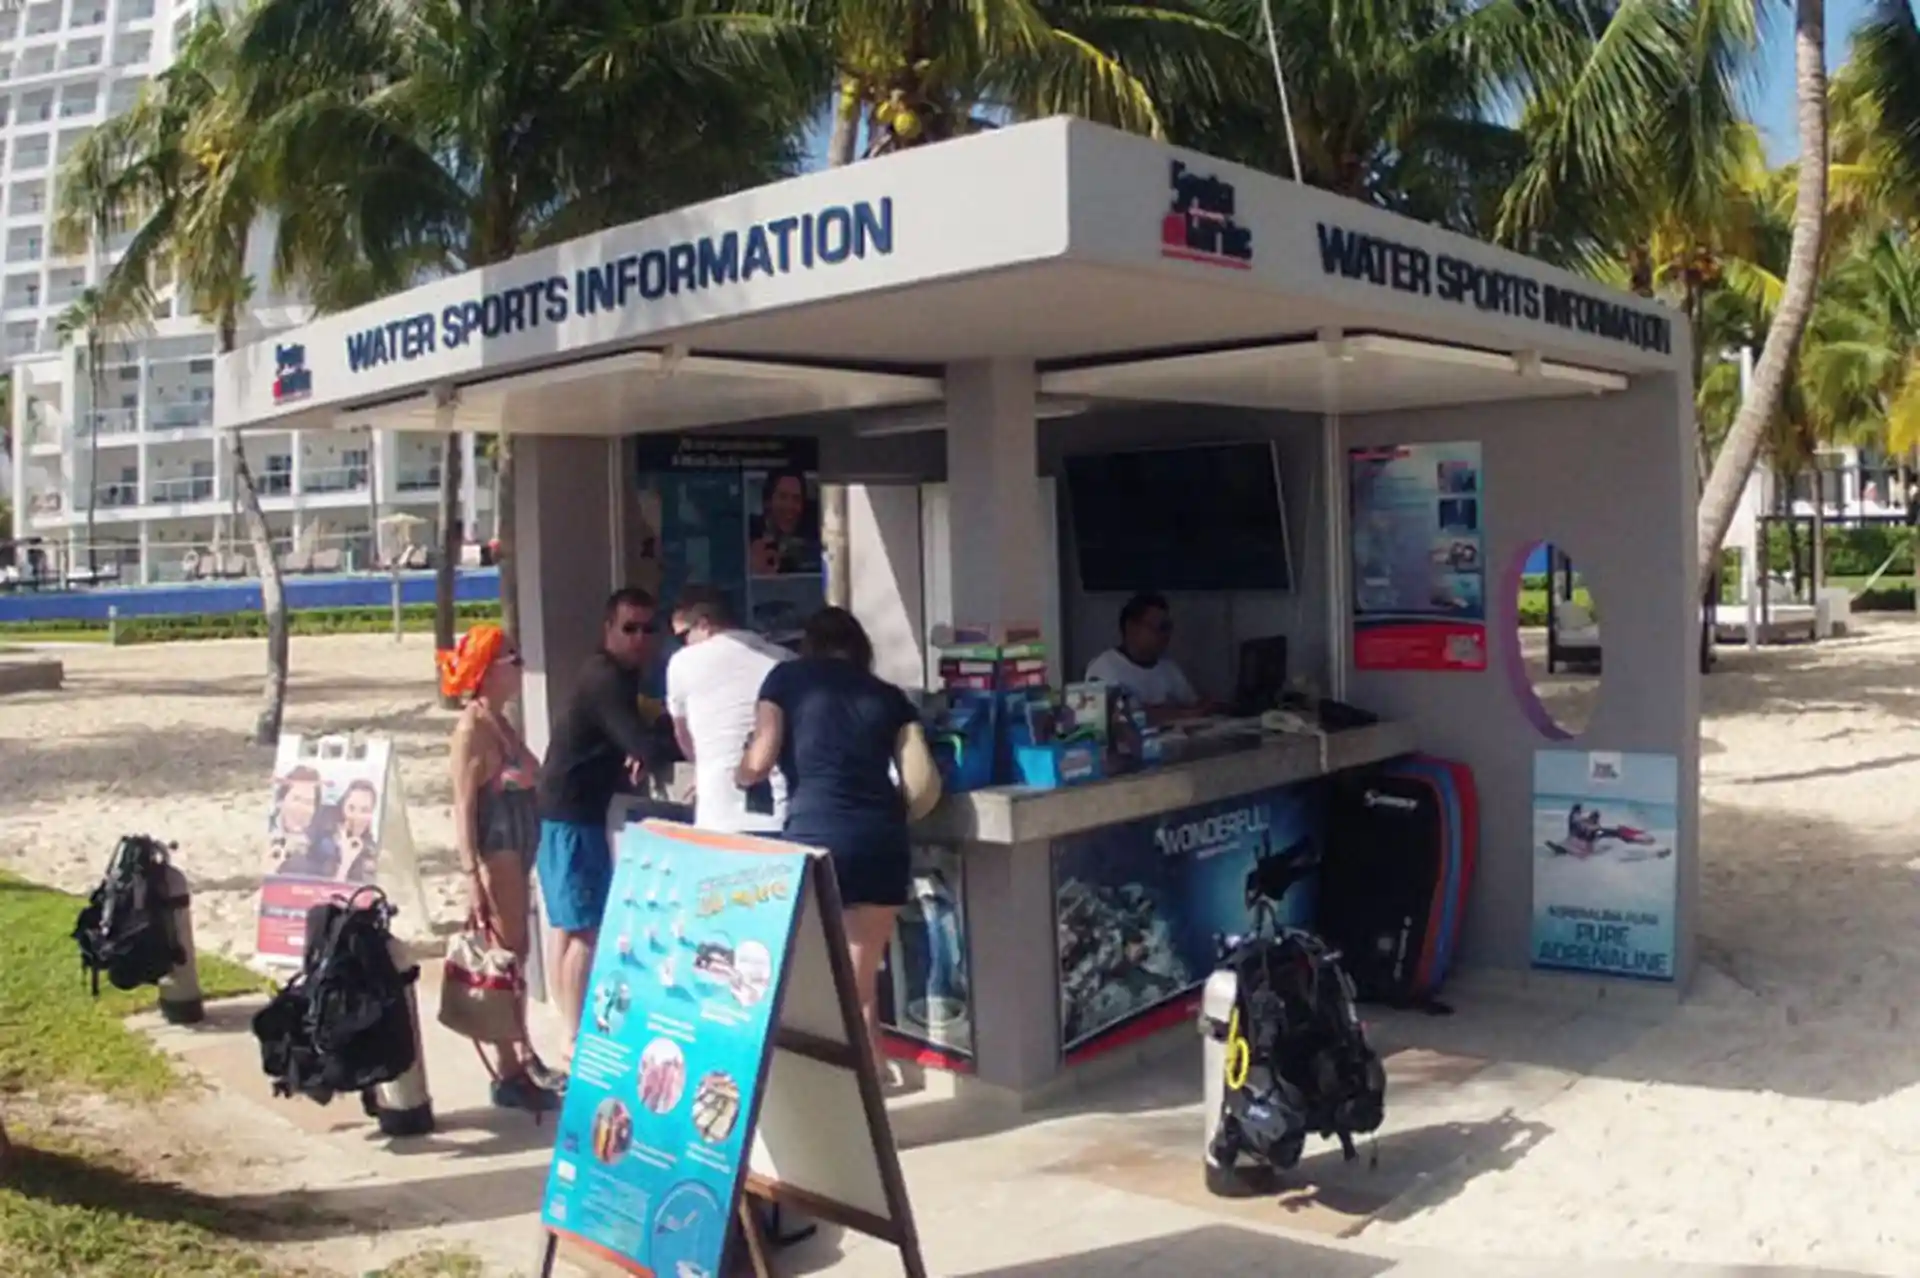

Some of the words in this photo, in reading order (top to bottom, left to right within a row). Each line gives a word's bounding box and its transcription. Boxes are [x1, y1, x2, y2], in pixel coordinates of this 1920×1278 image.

[348, 312, 436, 373] WATER
[442, 276, 568, 350] SPORTS
[576, 196, 893, 317] INFORMATION
[1316, 222, 1432, 297] WATER
[1436, 252, 1540, 320] SPORTS
[1544, 283, 1672, 355] INFORMATION
[1539, 939, 1669, 972] ADRENALINE
[1576, 922, 1630, 947] PURE
